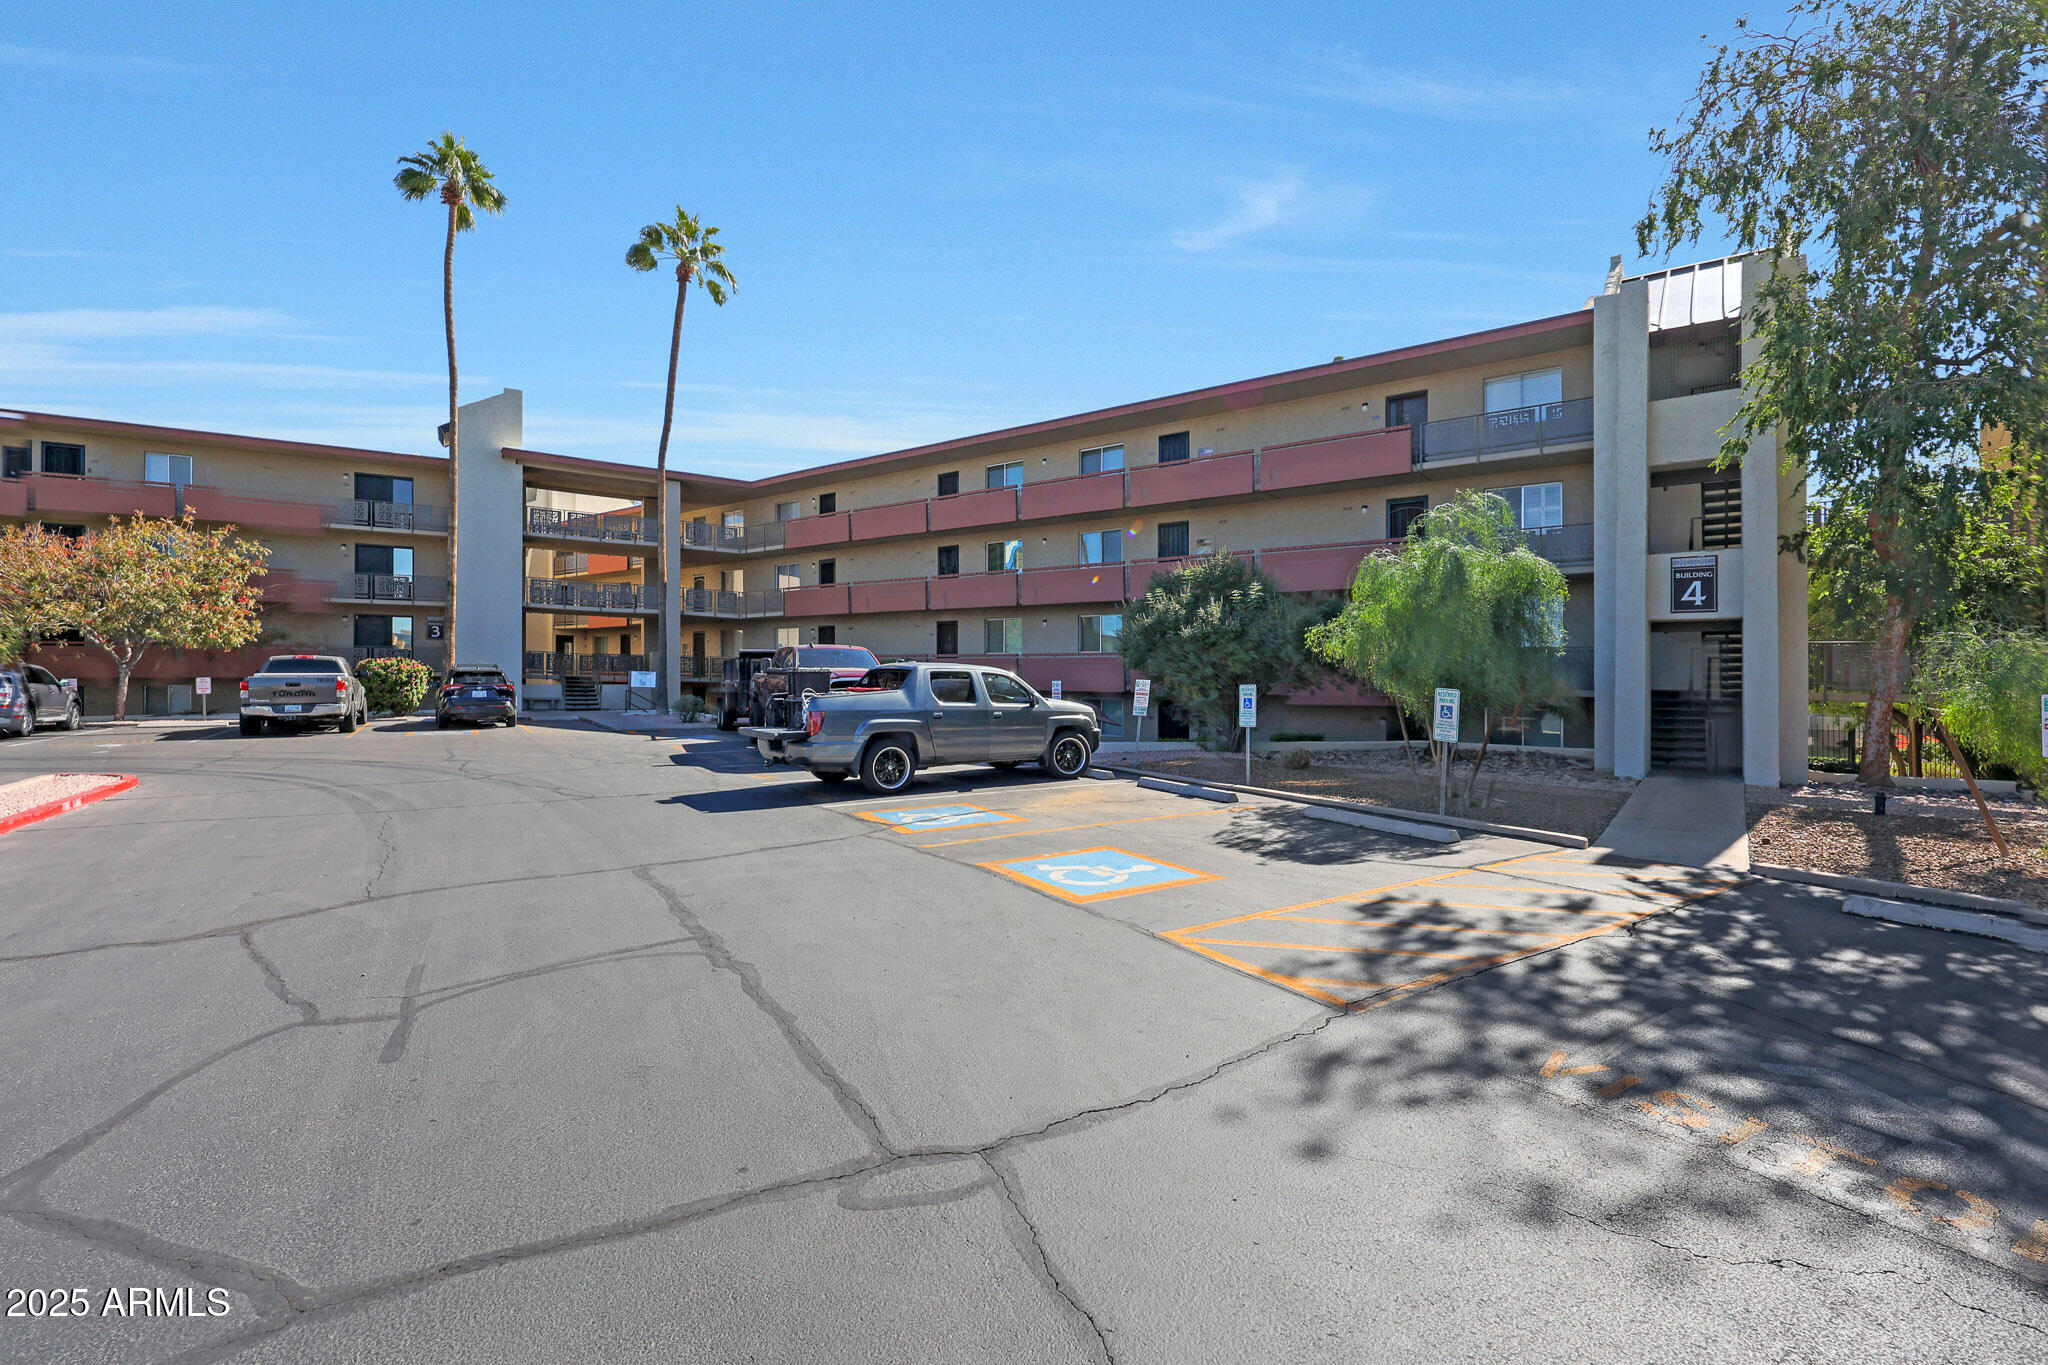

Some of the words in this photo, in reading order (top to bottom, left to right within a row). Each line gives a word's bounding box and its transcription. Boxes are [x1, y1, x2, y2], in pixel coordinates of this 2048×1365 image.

[1675, 571, 1713, 579] BUILDING
[1680, 580, 1707, 606] 4
[431, 625, 441, 638] 3
